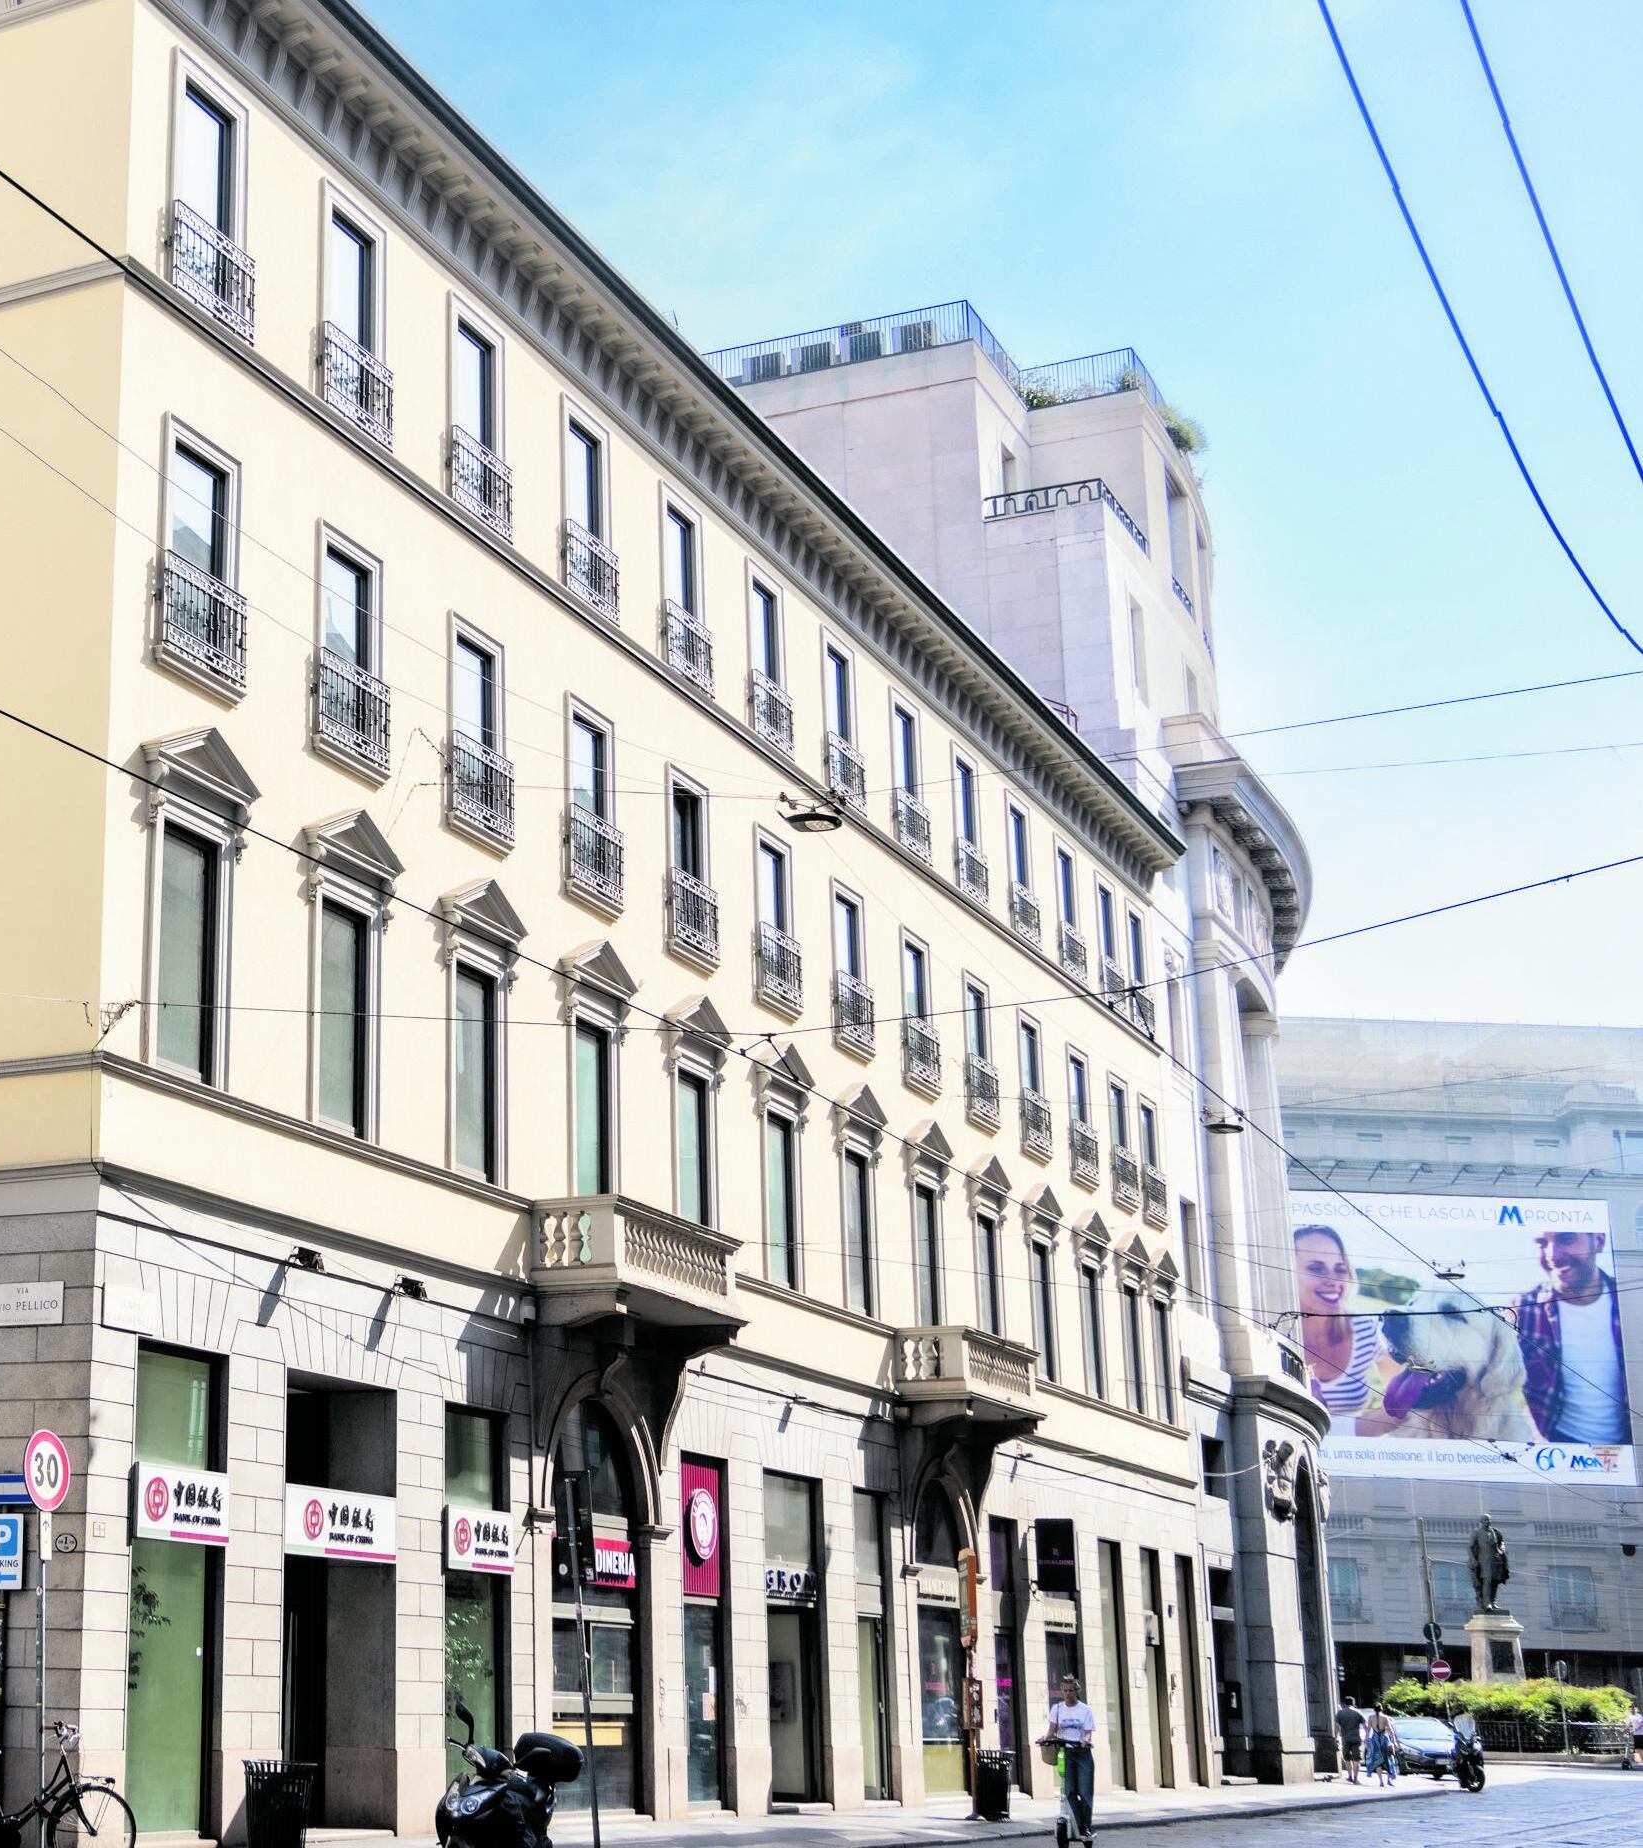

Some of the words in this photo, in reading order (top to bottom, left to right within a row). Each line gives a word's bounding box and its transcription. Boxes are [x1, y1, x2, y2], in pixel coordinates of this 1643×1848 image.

[1291, 1203, 1373, 1217] PASSIONE
[1379, 1205, 1413, 1218] CHE
[1419, 1207, 1477, 1220] LASCIA
[16, 1287, 29, 1295] VIA
[15, 1300, 58, 1311] PELLICO
[1334, 1452, 1353, 1460] una
[1356, 1450, 1375, 1460] sola
[1436, 1451, 1454, 1462] loro
[34, 1452, 59, 1489] 30
[173, 1513, 191, 1522] BANK
[192, 1515, 201, 1523] OF
